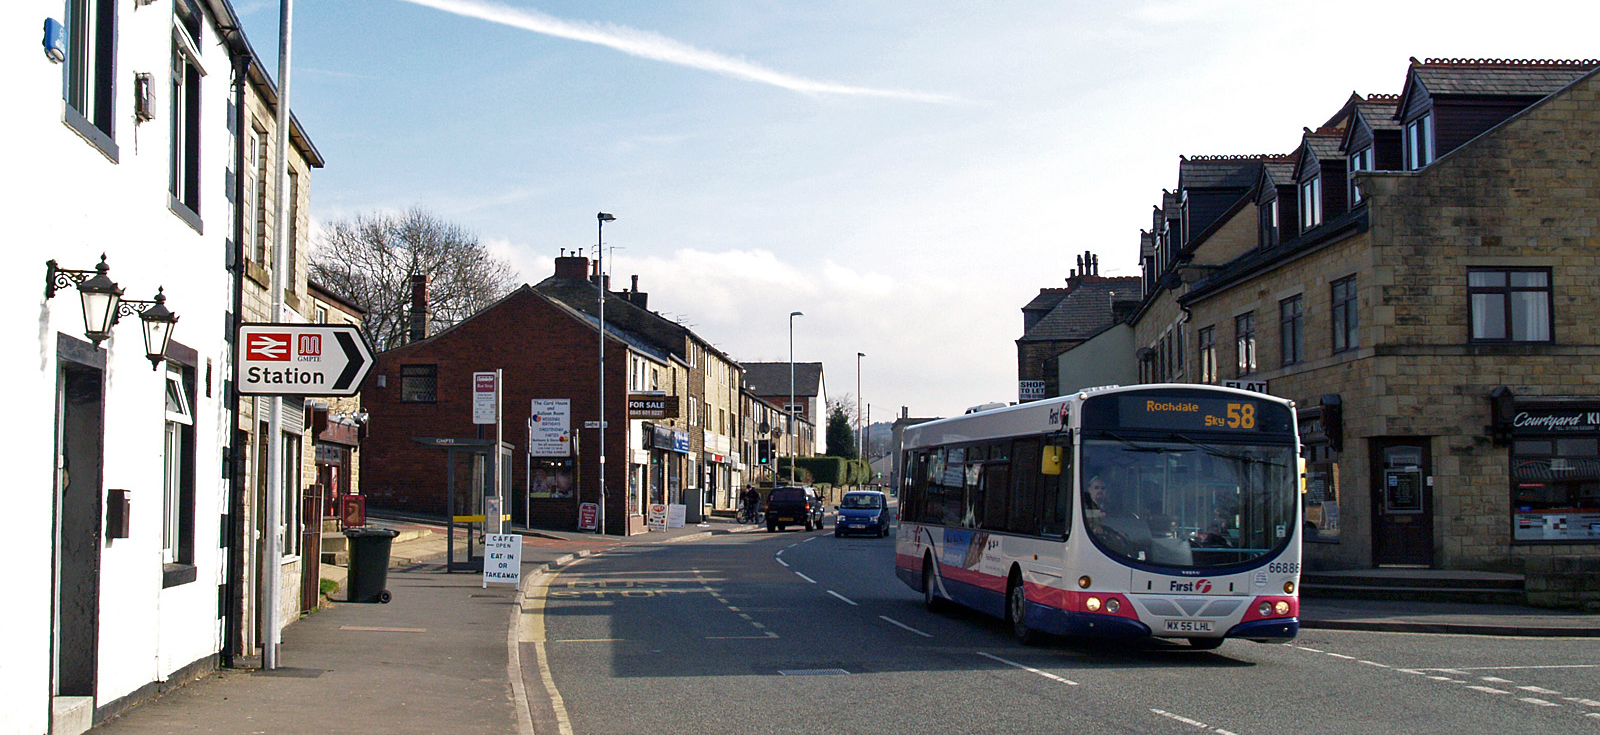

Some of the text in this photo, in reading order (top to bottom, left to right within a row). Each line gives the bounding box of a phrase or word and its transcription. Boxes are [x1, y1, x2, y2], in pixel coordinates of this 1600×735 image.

[246, 366, 324, 384] Station
[1146, 400, 1199, 412] Rochdale
[1204, 403, 1255, 429] Sky 58
[1513, 411, 1583, 431] Courtyard
[1269, 562, 1300, 573] 66886
[1170, 580, 1193, 592] First
[1167, 622, 1211, 631] MX 55 LHL
